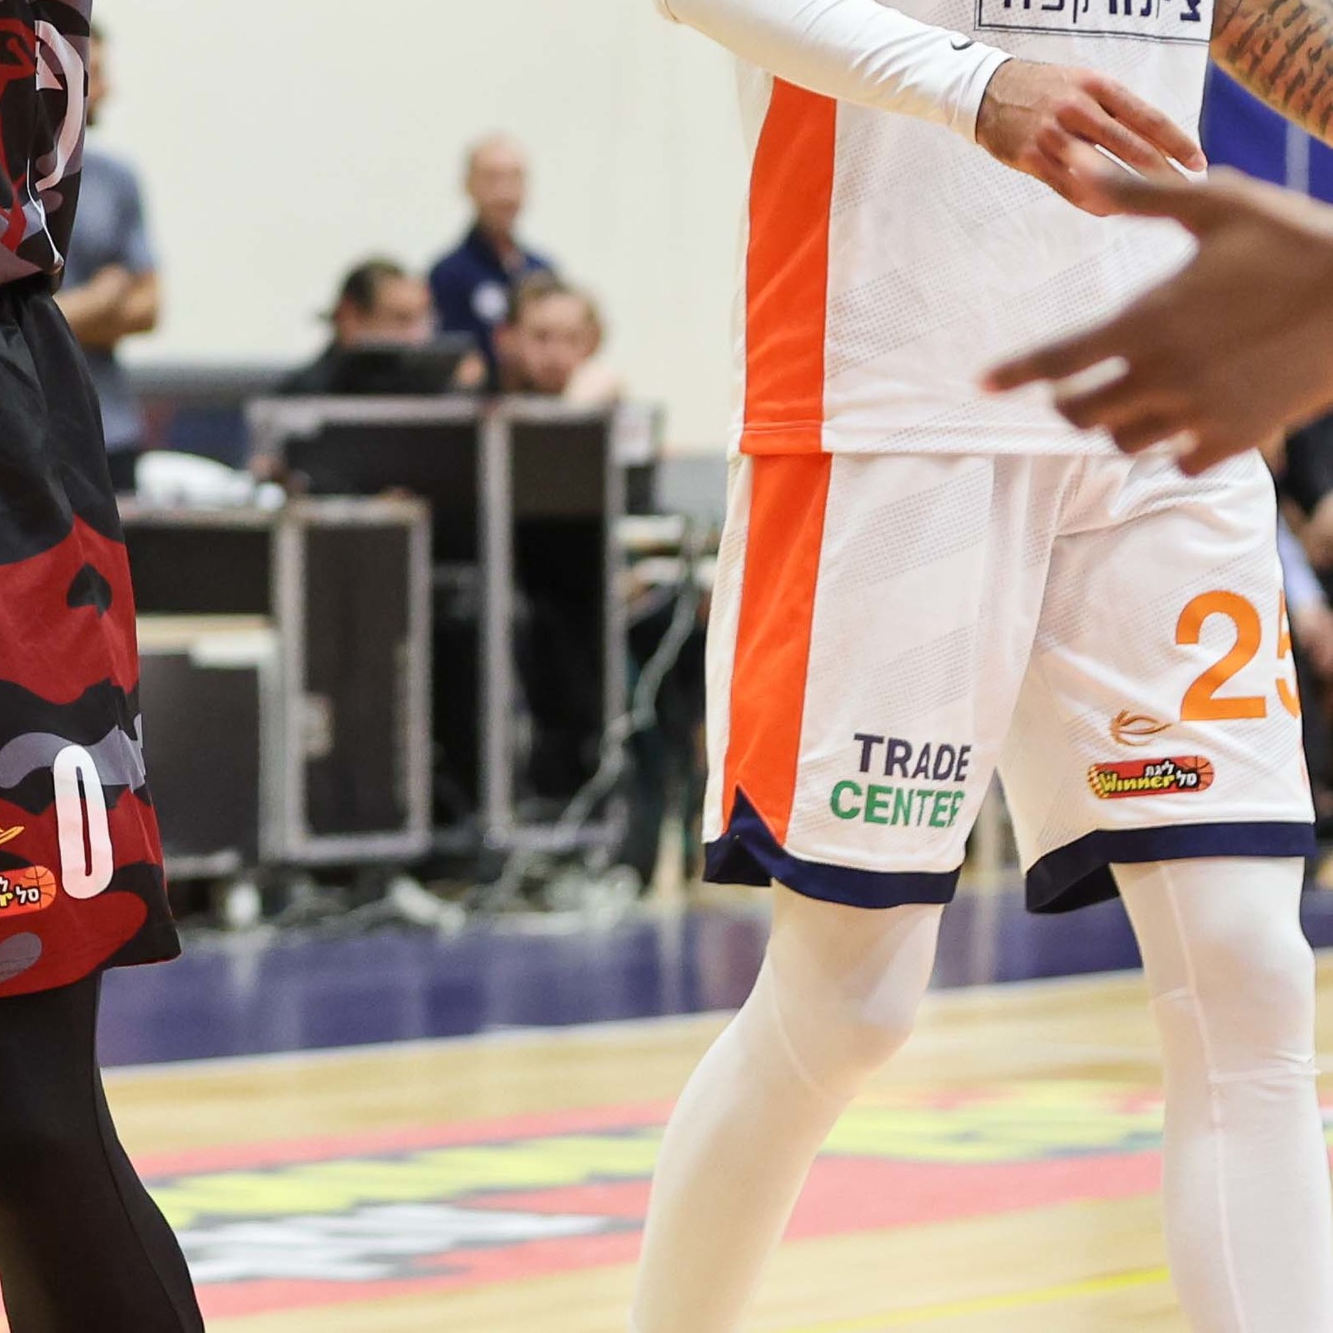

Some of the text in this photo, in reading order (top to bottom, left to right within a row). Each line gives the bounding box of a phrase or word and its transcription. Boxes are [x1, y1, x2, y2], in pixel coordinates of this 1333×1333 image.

[853, 732, 972, 782] TRADE
[1098, 769, 1198, 793] Winner סל
[53, 744, 114, 899] 0
[829, 779, 966, 828] CENTER
[16, 885, 40, 904] סל
